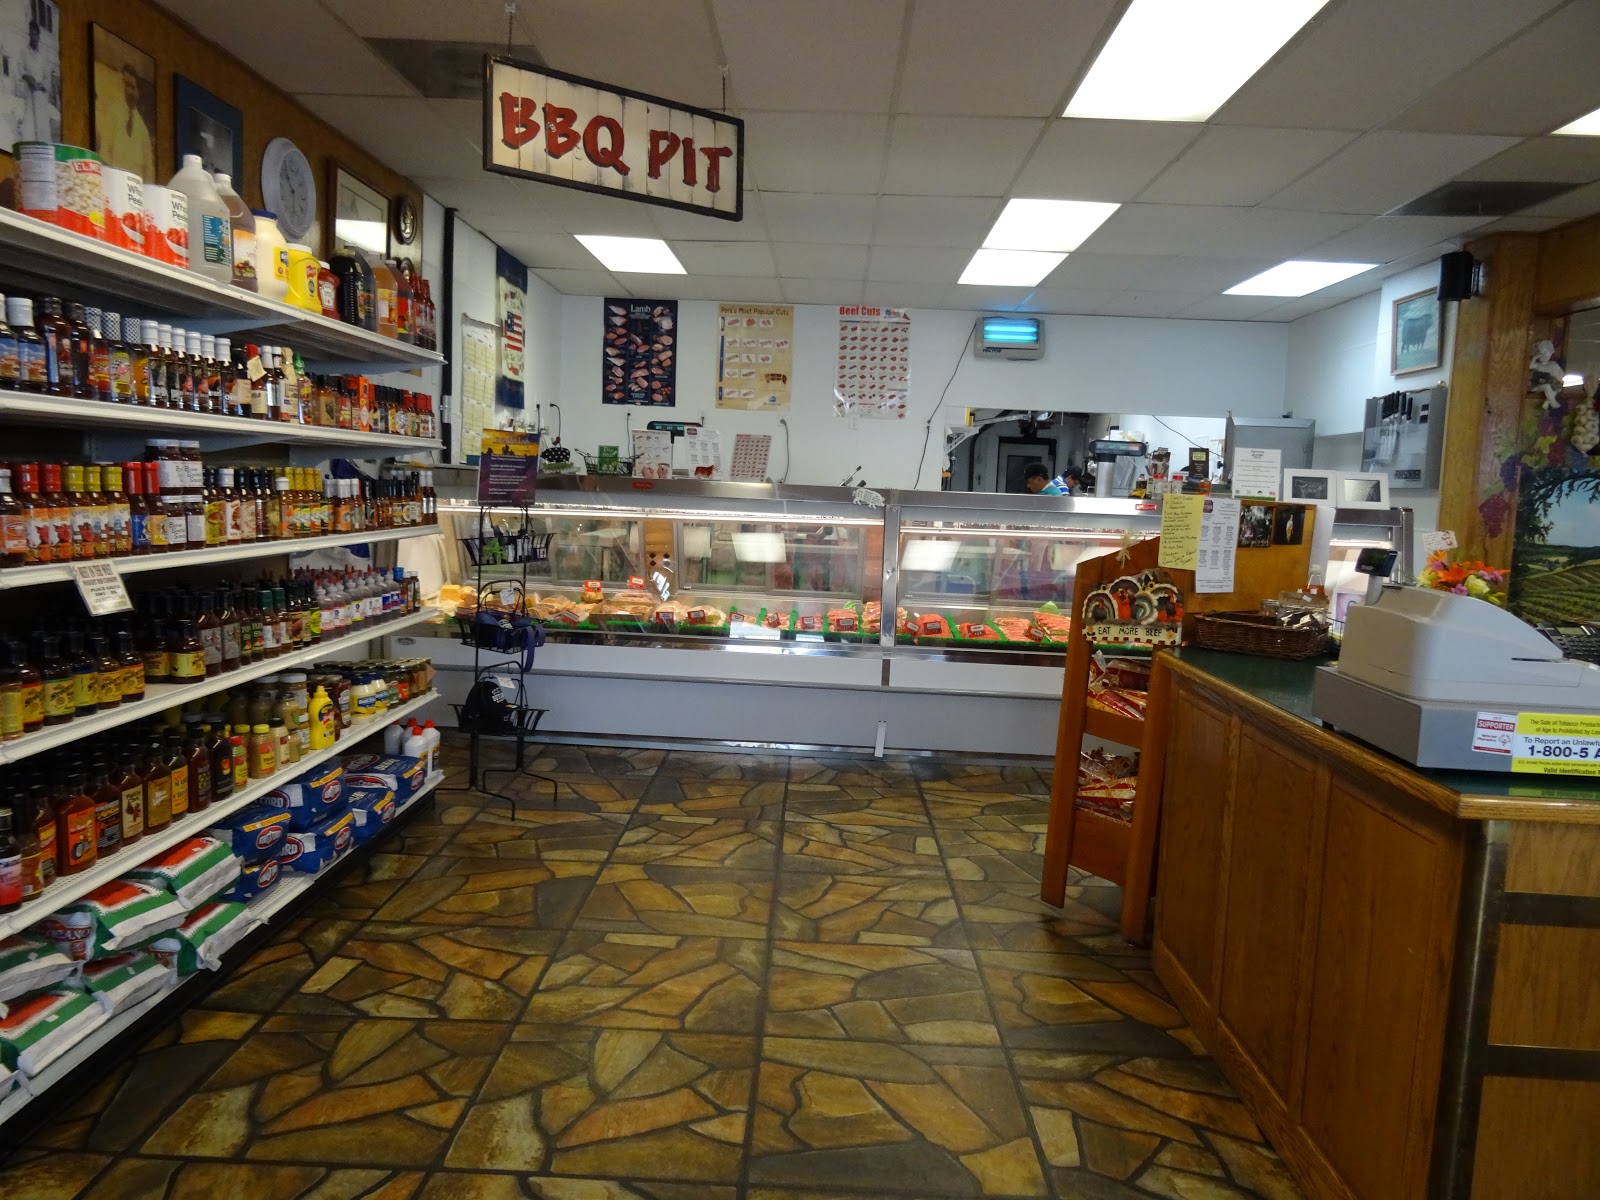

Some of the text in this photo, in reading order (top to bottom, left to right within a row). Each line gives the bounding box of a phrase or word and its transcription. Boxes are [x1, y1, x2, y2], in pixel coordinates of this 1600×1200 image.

[499, 92, 733, 192] BBQ PIT
[630, 304, 651, 313] Lamb
[739, 307, 752, 315] Most
[754, 308, 775, 316] Popular
[839, 306, 860, 316] Beef
[861, 306, 881, 316] Cuts
[1097, 626, 1162, 637] EAT MORE BEEF
[1478, 720, 1514, 731] SUPPORTER
[1534, 737, 1560, 746] Report
[1528, 745, 1589, 758] 1-800-5
